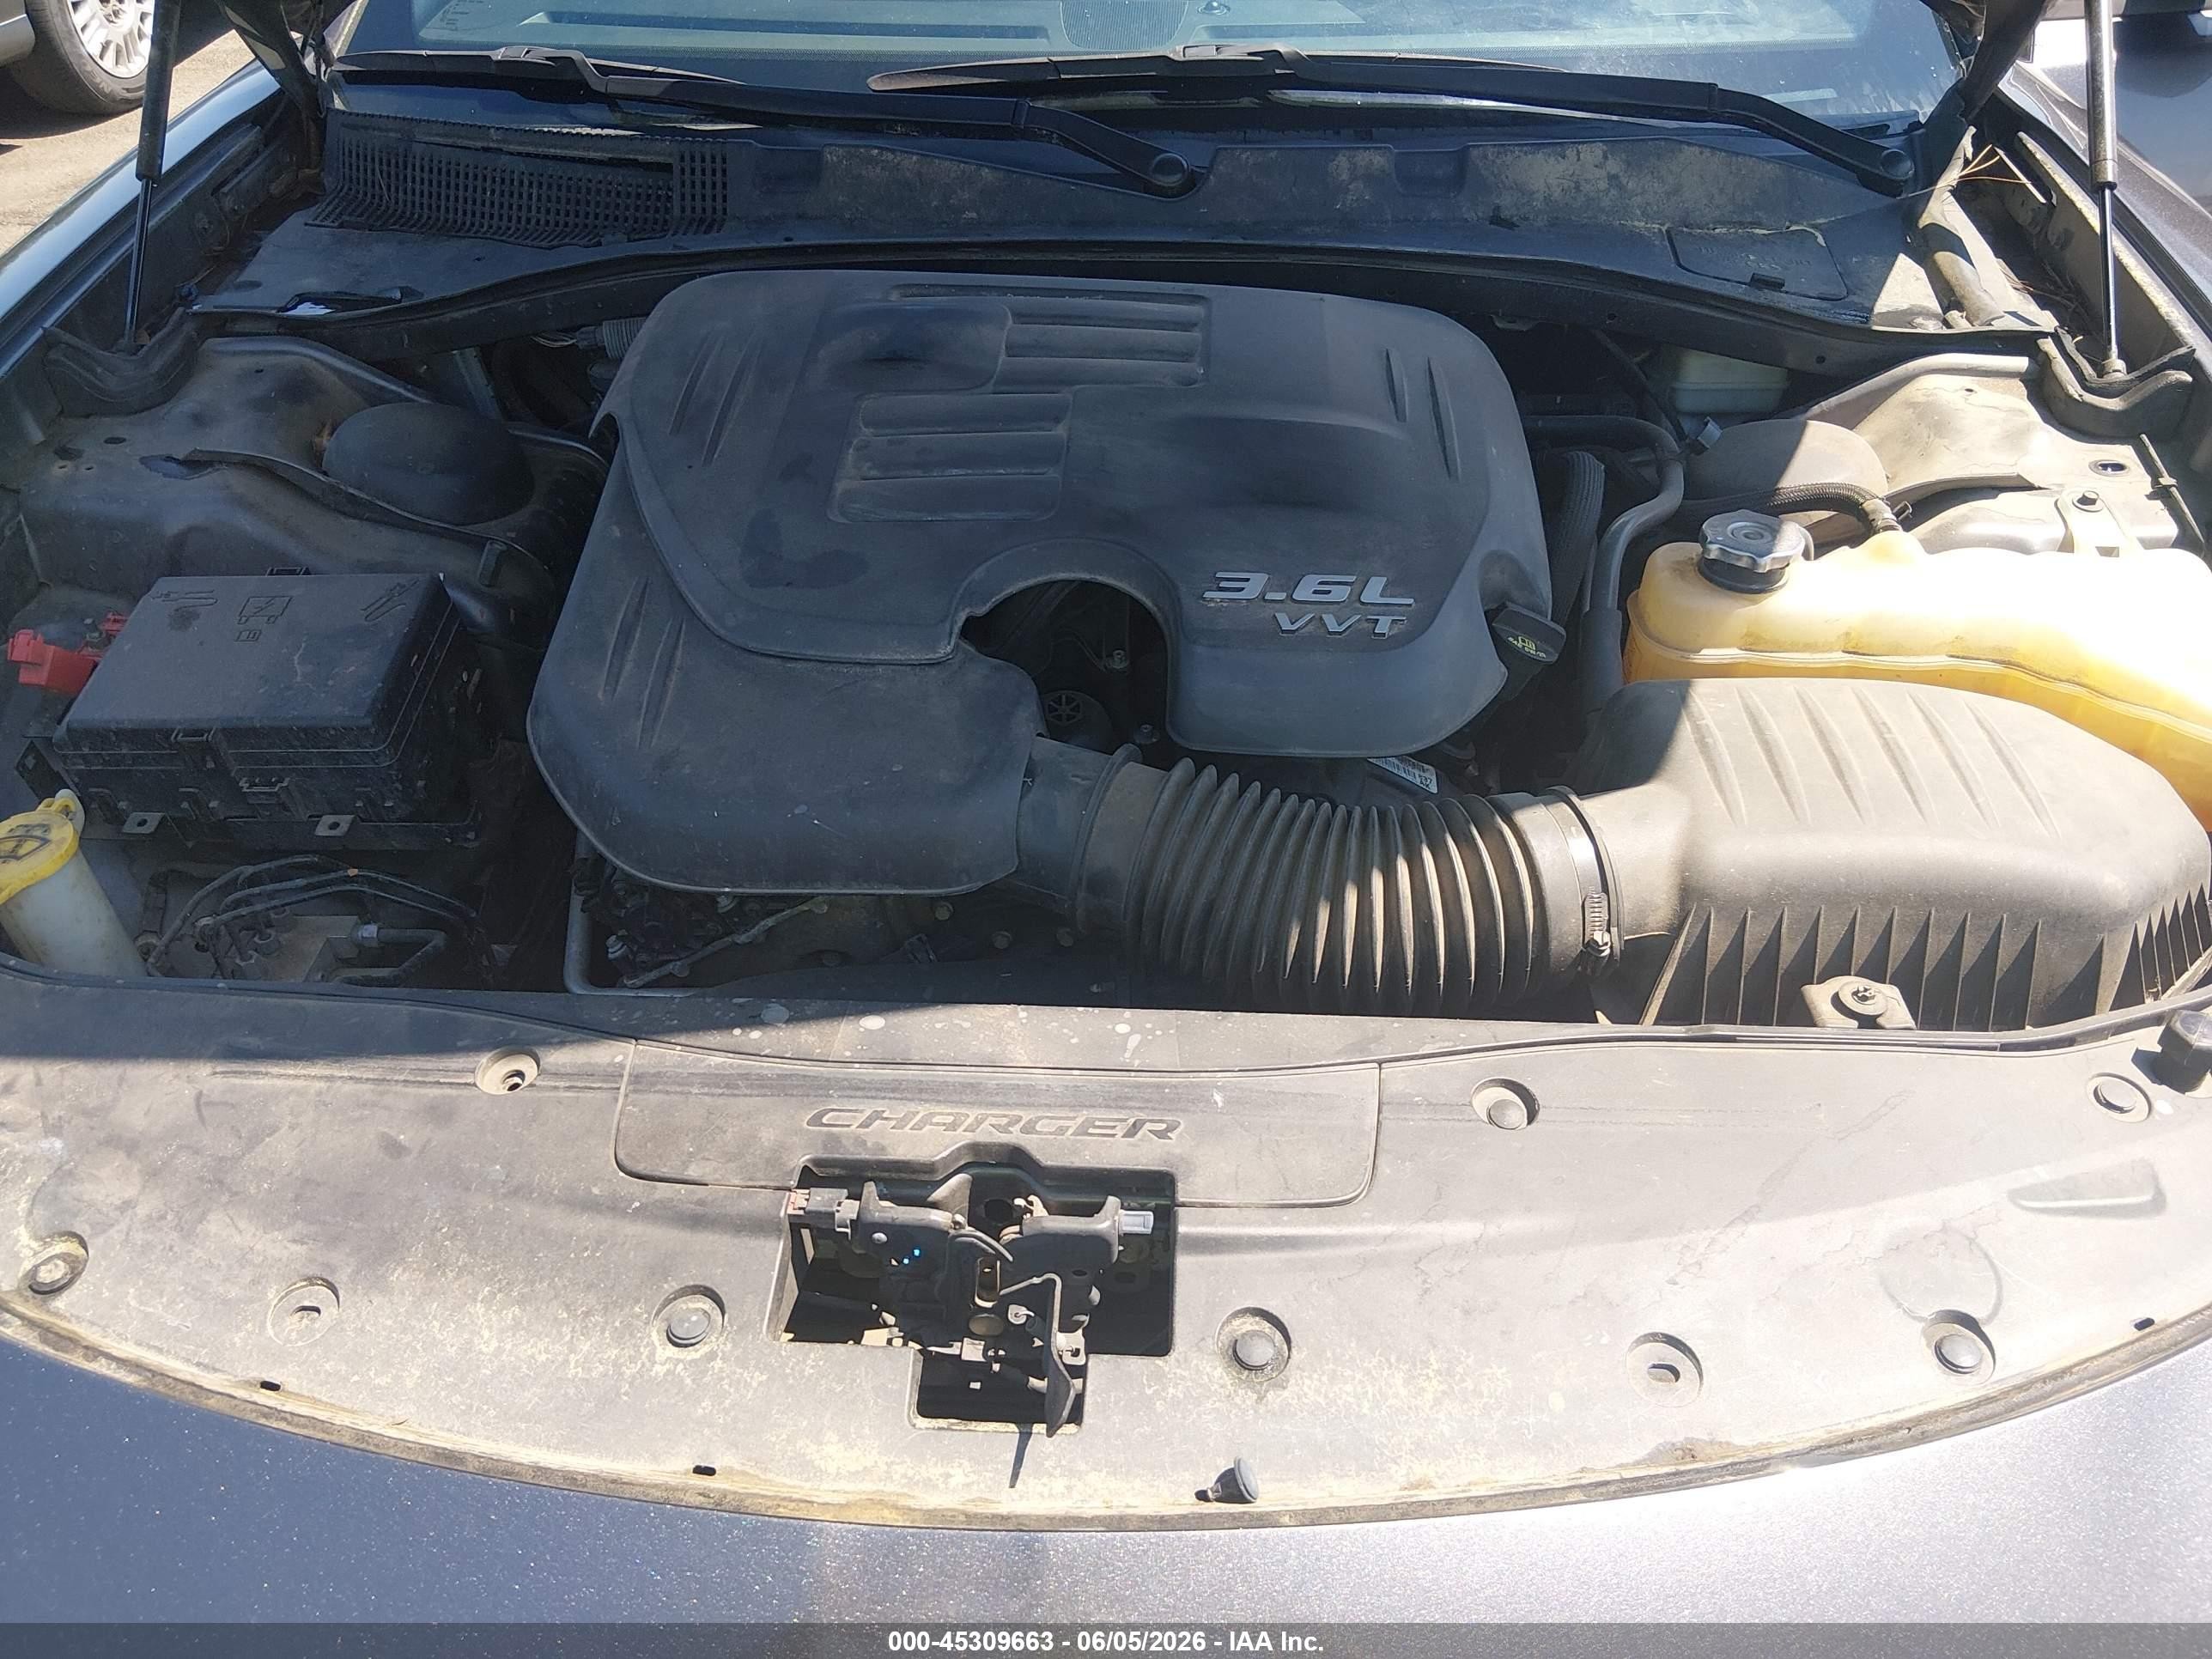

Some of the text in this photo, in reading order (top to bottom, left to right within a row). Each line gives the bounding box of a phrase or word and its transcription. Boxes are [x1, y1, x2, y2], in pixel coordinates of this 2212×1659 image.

[1202, 571, 1415, 605] 3.6L
[1274, 612, 1407, 638] VVT
[805, 1108, 1182, 1140] CHARGER
